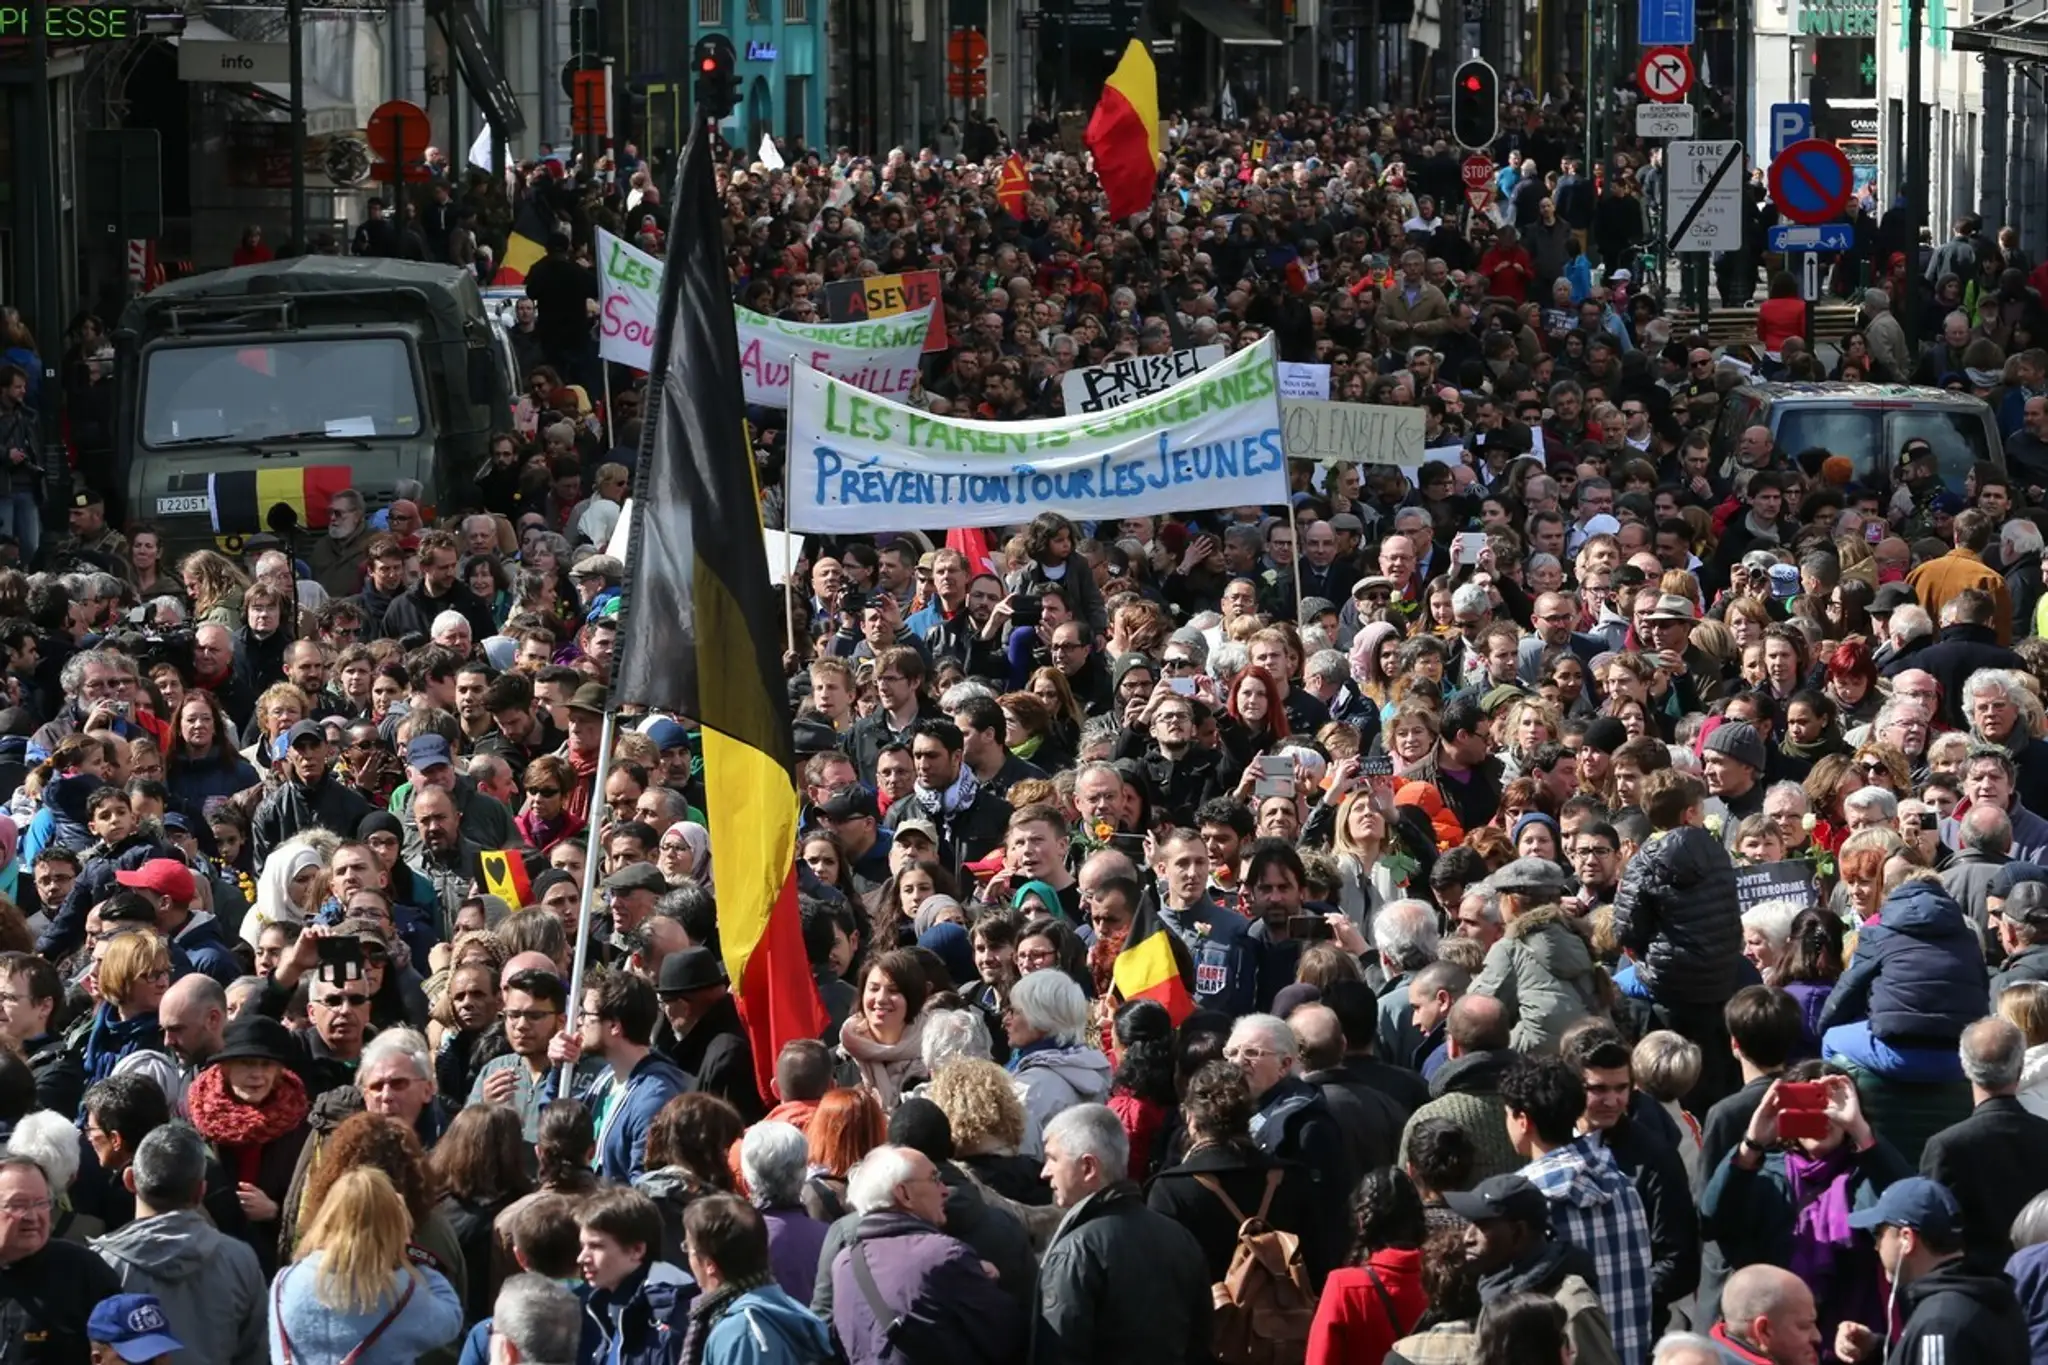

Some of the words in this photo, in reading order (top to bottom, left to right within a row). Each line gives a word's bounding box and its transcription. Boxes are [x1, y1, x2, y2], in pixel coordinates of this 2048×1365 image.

[221, 54, 254, 70] info
[1687, 145, 1723, 157] ZONE
[1776, 112, 1804, 152] P
[1463, 165, 1492, 179] STOP
[607, 241, 653, 289] LES
[847, 284, 929, 315] ASEVE
[811, 350, 918, 394] FMILLE
[1082, 348, 1207, 401] BRUSSEL
[824, 380, 893, 442] LES
[1281, 405, 1409, 460] OLENBEEK
[1147, 428, 1284, 490] JEUNES
[1737, 887, 1751, 900] LE
